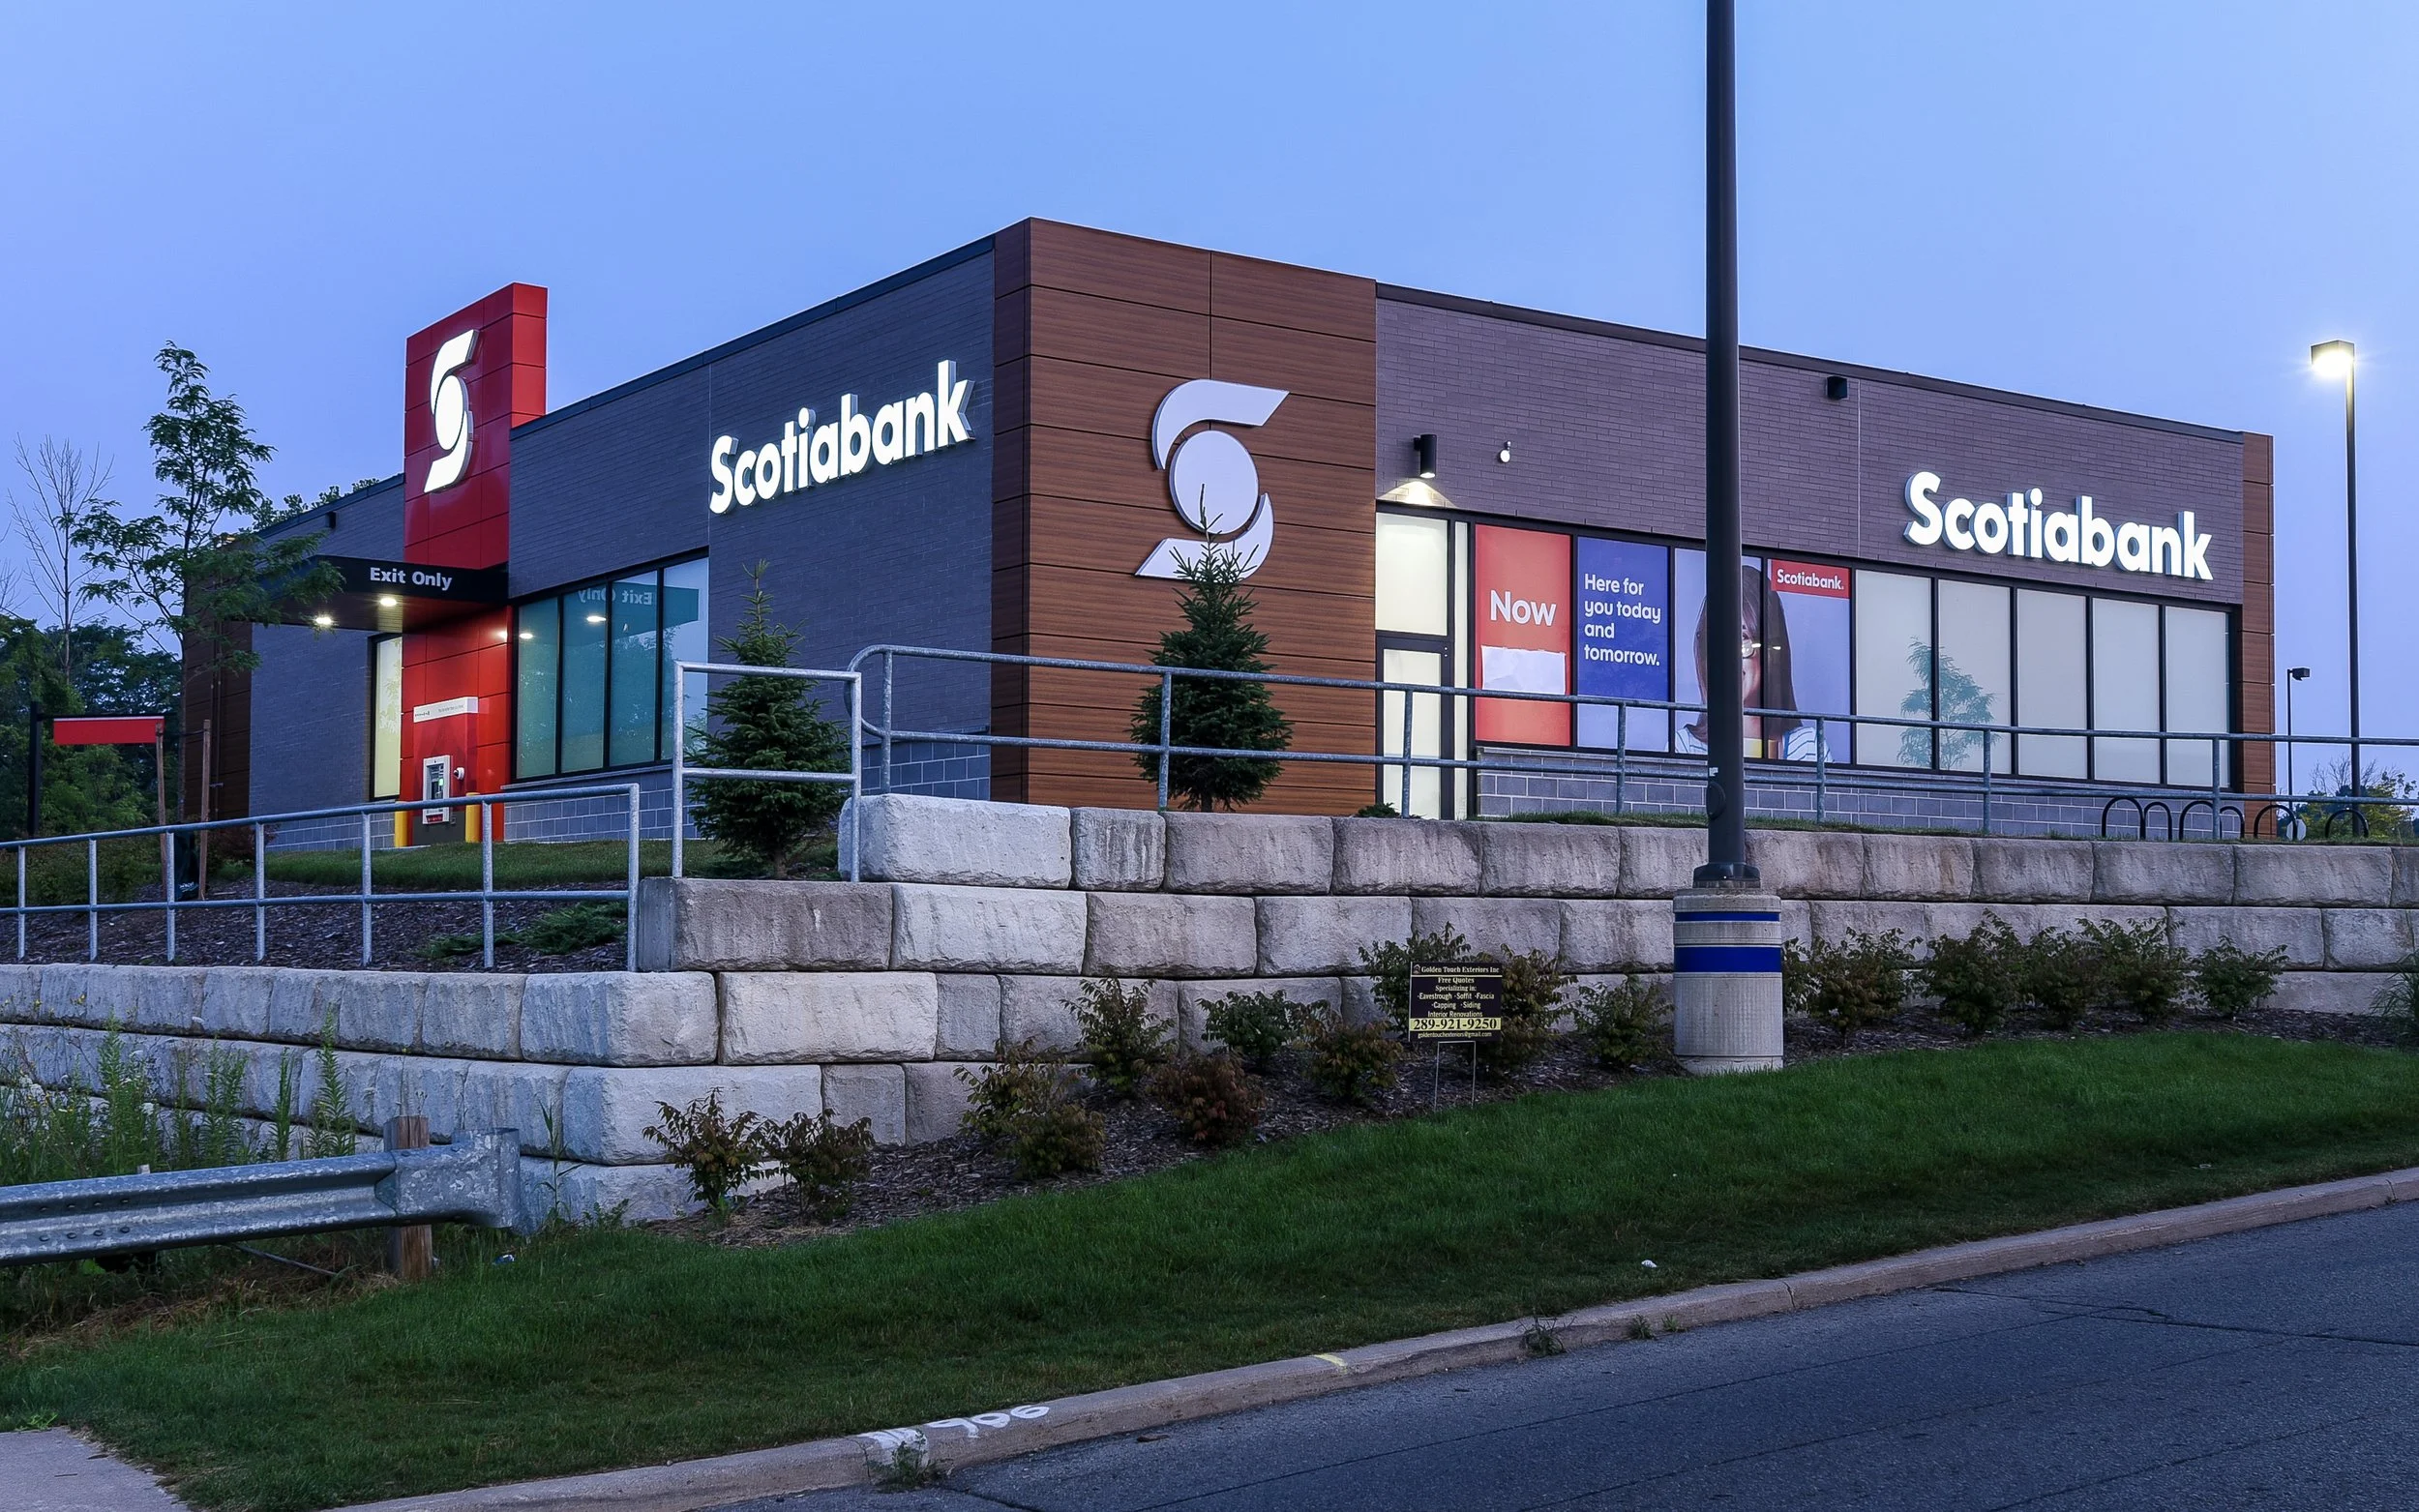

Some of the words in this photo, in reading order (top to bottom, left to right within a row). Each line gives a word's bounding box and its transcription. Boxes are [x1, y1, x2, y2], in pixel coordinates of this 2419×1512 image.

[709, 359, 976, 515] Scotiabank
[1903, 471, 2214, 580] Scotiabank
[370, 567, 406, 584] Exit
[411, 571, 453, 591] Only
[1584, 573, 1620, 595] Here
[1623, 577, 1644, 596] for
[1490, 589, 1557, 627] Now
[1584, 602, 1614, 619] you
[1617, 602, 1661, 624] today
[1584, 622, 1615, 640] and
[1584, 643, 1660, 667] tomorrow.
[1414, 1019, 1496, 1029] 289-921-9250
